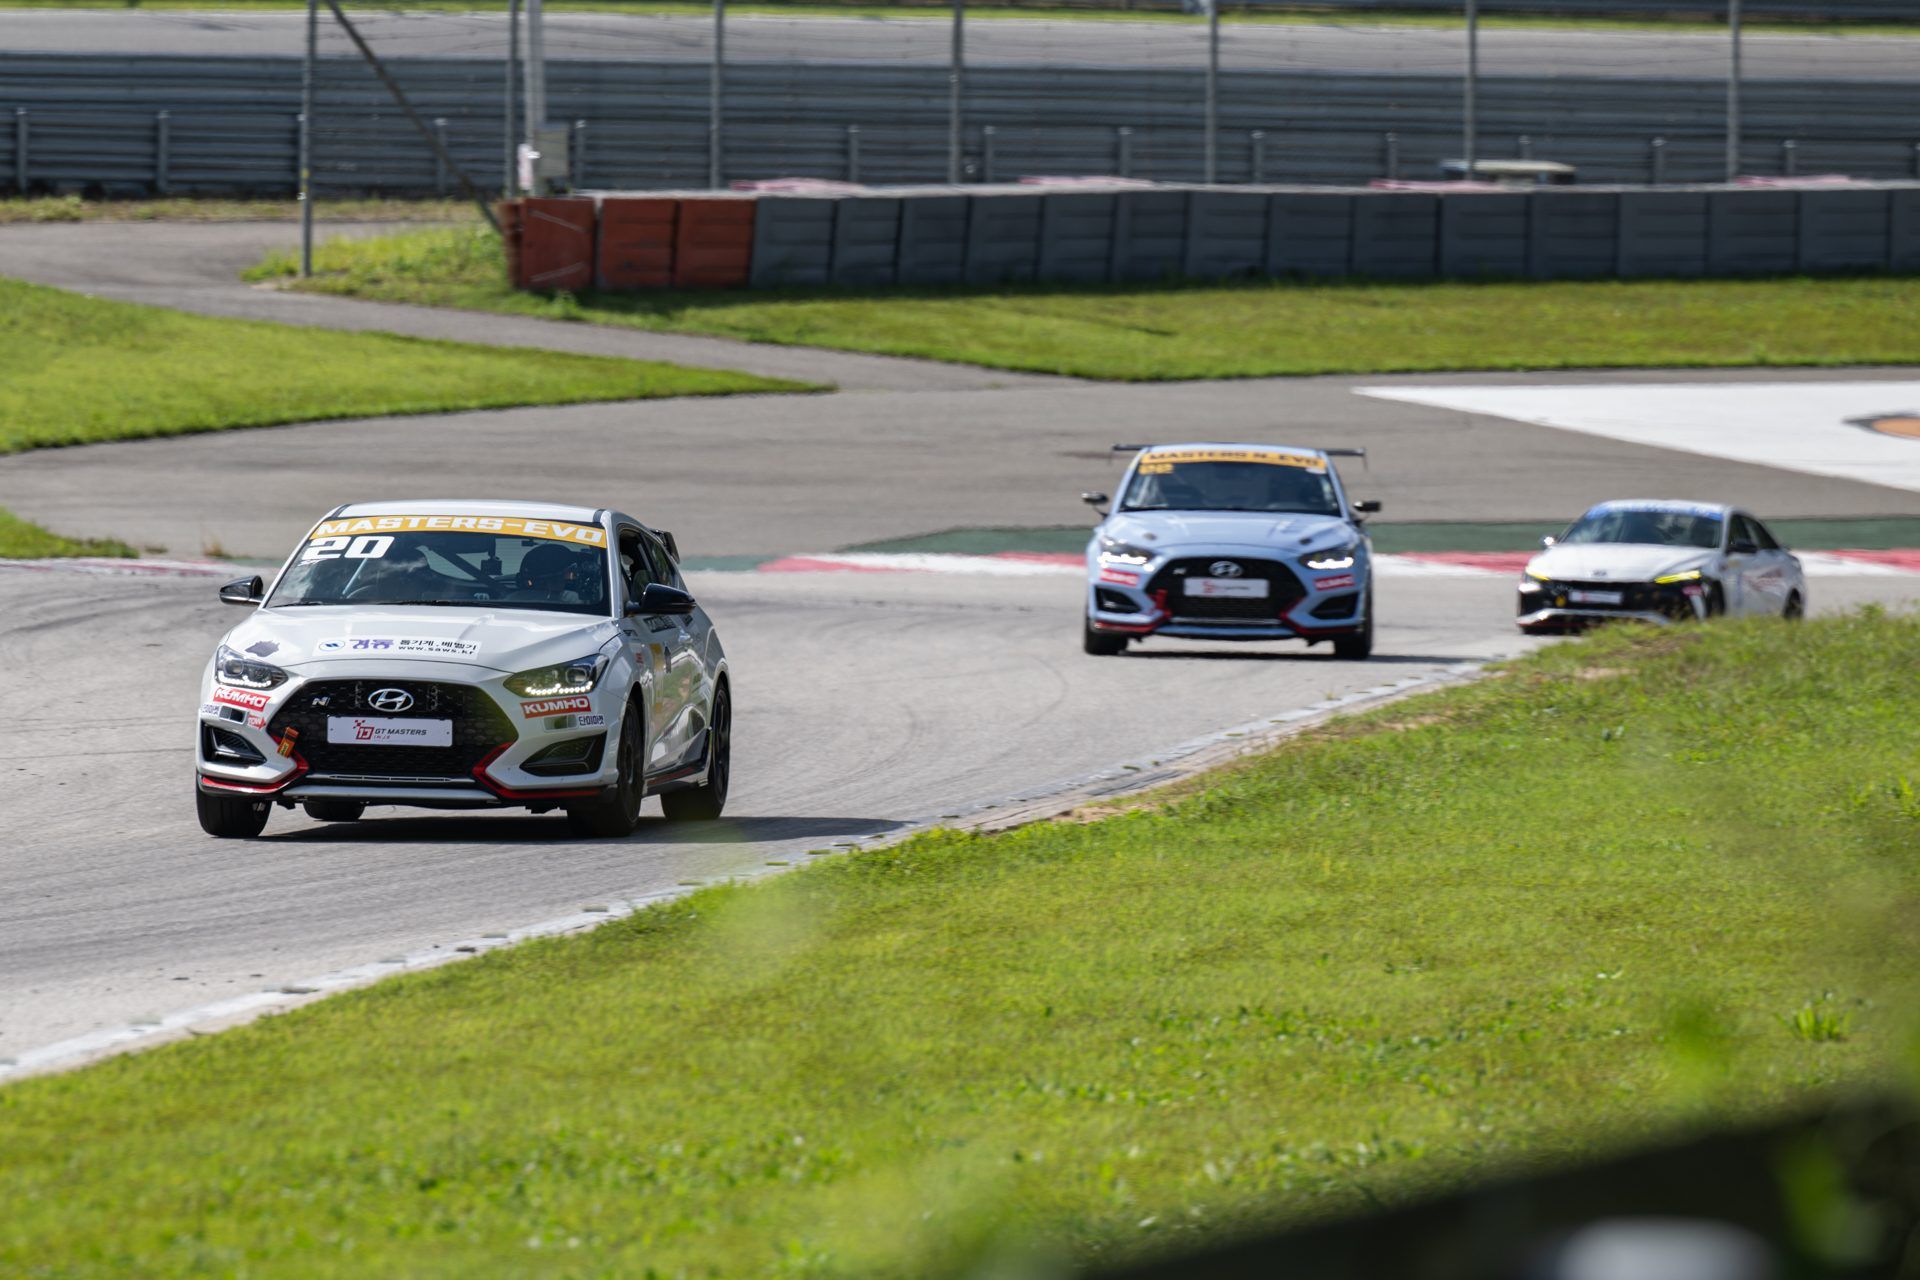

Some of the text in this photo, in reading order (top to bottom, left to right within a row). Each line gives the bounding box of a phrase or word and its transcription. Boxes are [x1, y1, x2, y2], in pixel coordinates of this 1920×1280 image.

[317, 515, 604, 543] MASTERS-EVO
[301, 536, 395, 560] 20
[214, 687, 265, 707] KUMHO
[523, 698, 589, 714] KUMHO
[387, 728, 427, 736] MASTERS
